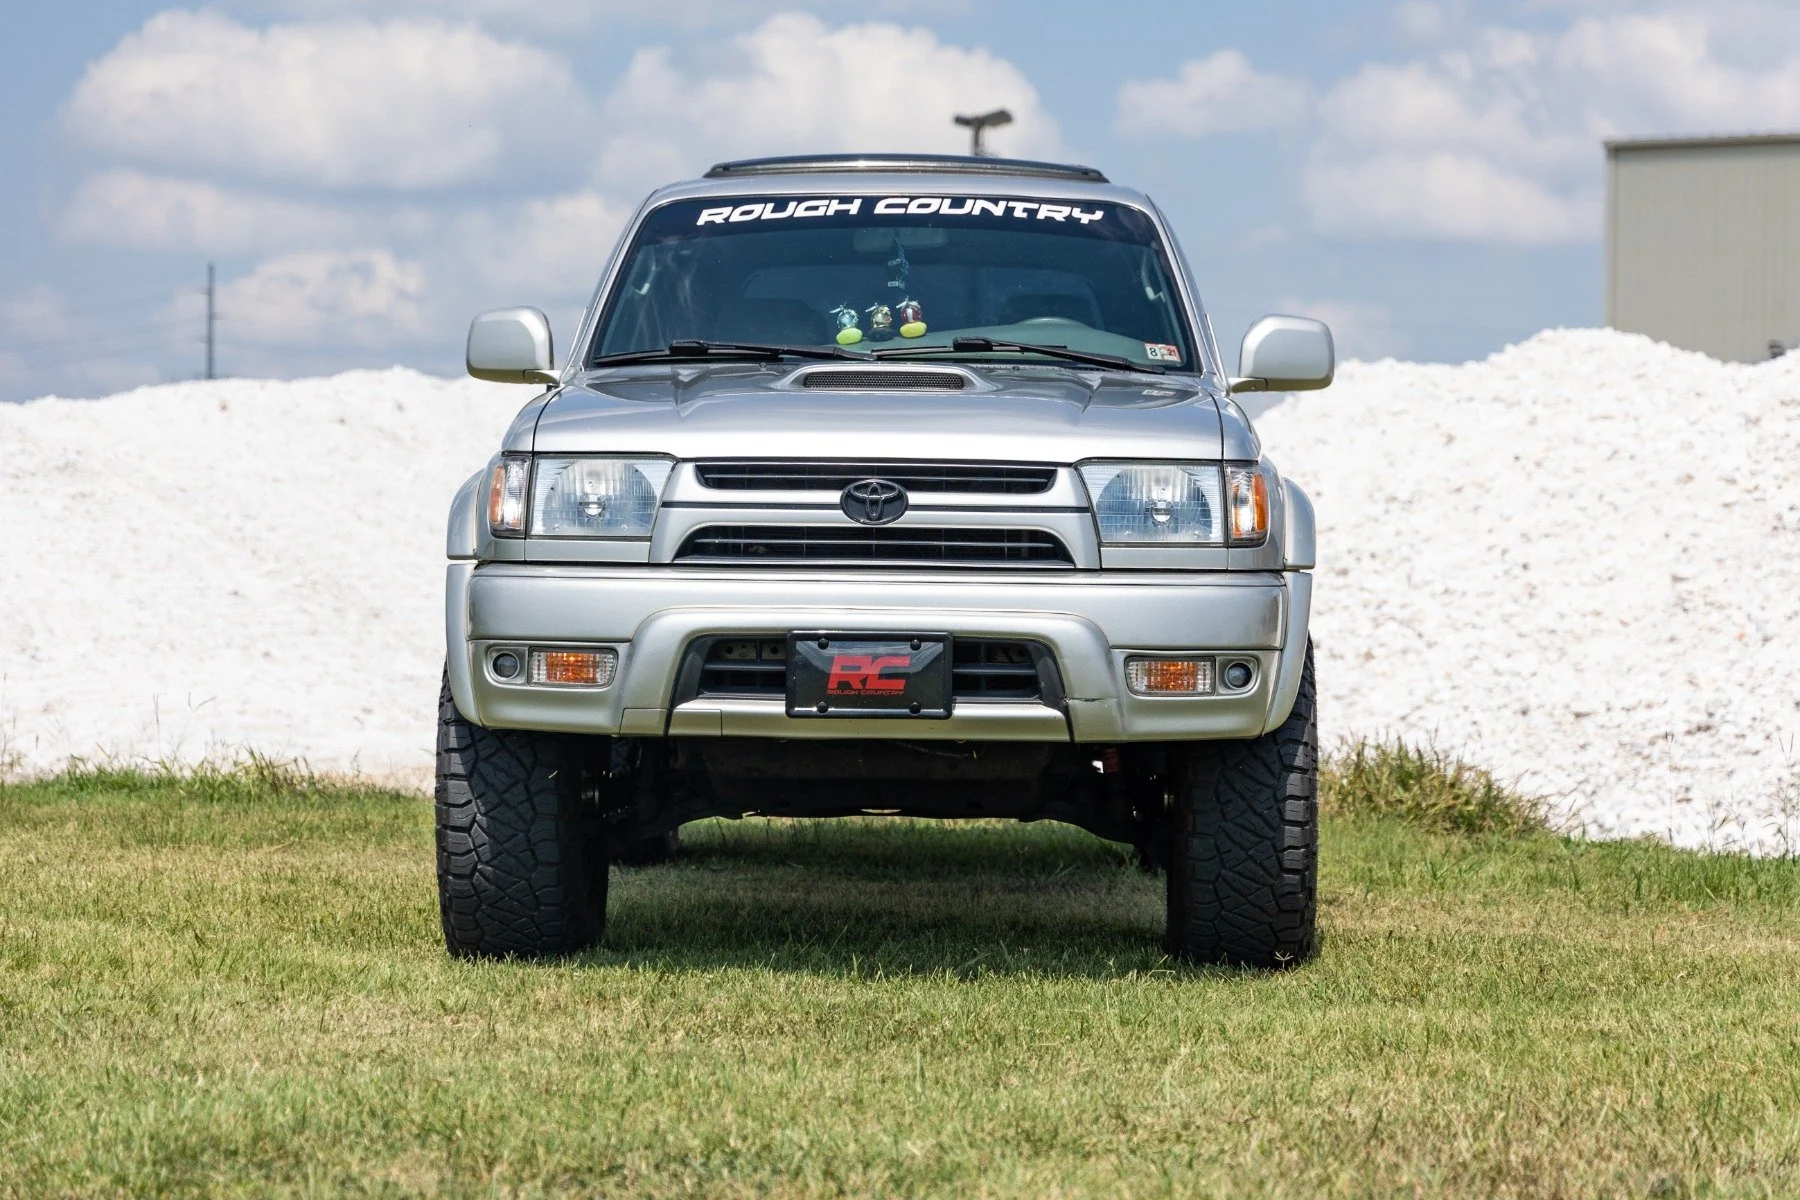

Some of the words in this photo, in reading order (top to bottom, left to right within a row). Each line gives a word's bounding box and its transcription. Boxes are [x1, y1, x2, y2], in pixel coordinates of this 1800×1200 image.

[696, 198, 862, 226] ROUGH
[873, 197, 1105, 225] COUNTRY
[1149, 347, 1158, 356] 8
[1167, 348, 1177, 356] 21
[828, 655, 911, 689] RC
